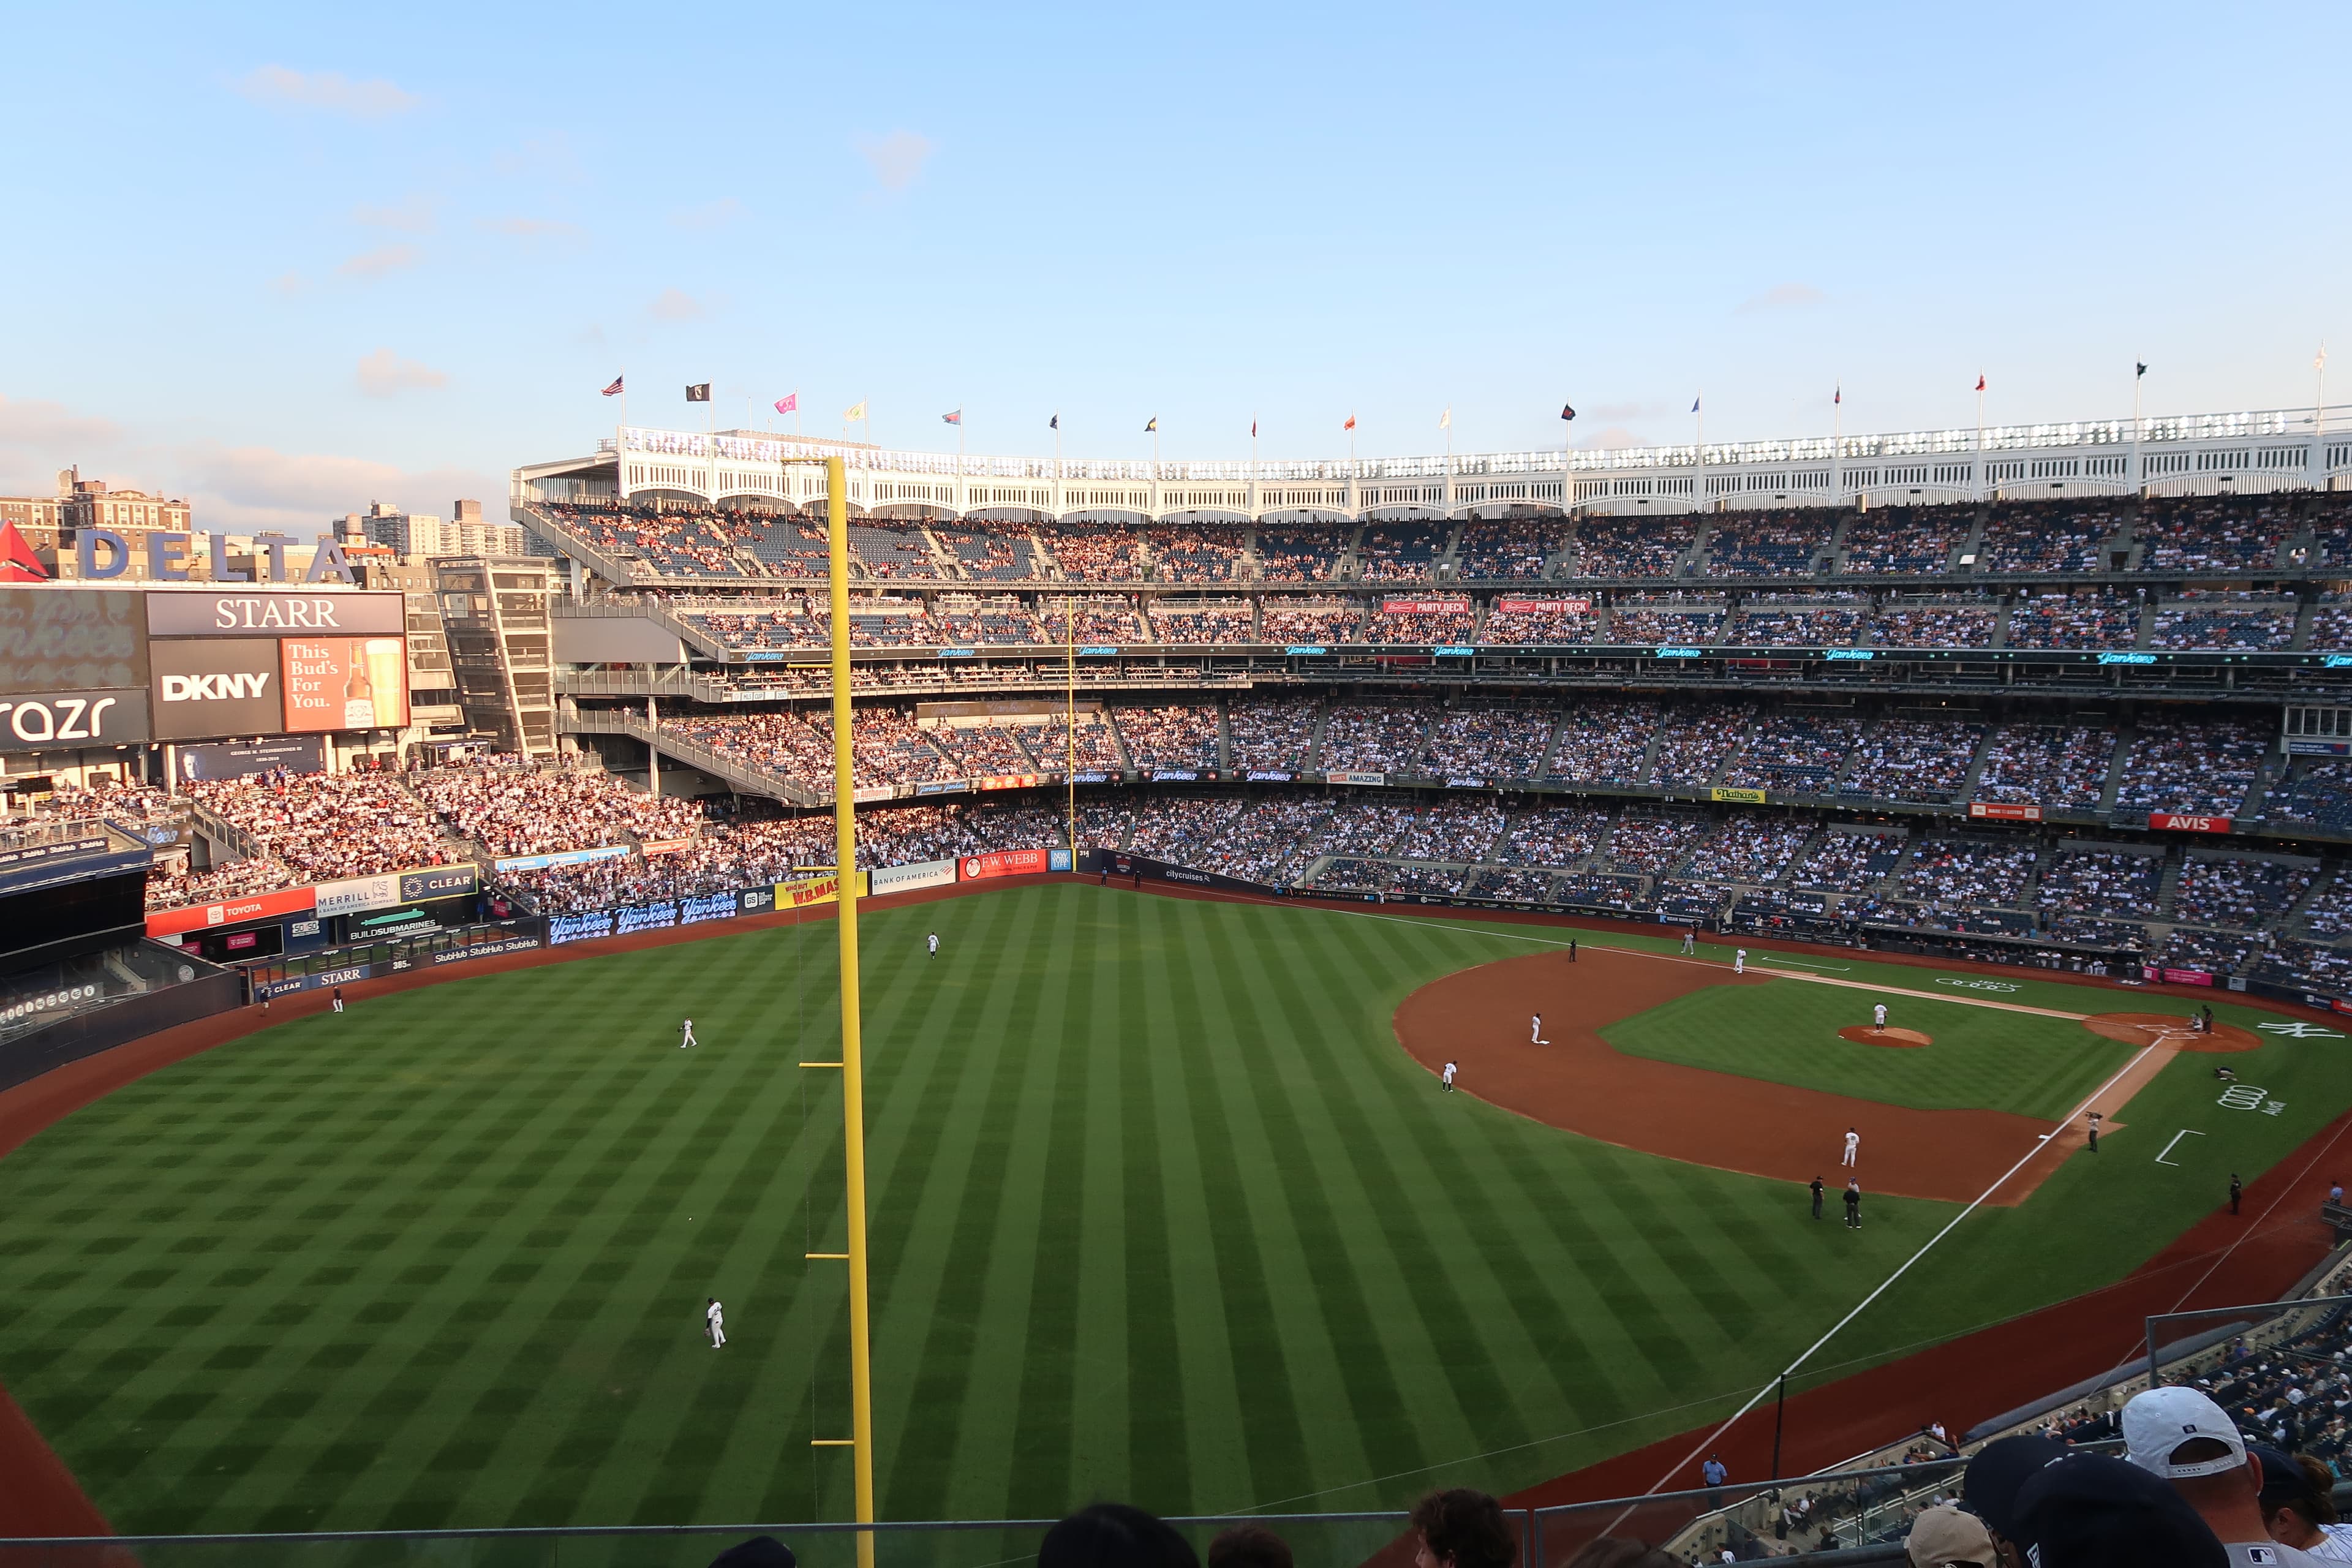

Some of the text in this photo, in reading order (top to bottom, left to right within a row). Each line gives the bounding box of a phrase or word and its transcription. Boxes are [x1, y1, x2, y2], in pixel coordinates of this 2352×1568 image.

[75, 529, 355, 582] DELTA
[1417, 603, 1442, 612] PARTY
[1443, 603, 1465, 612] DECK
[1536, 602, 1561, 611] PARTY
[1563, 602, 1586, 611] DECK
[216, 599, 341, 628] STARR
[288, 644, 330, 659] This
[744, 651, 784, 662] Yankees
[937, 648, 975, 658] Yankees
[1079, 646, 1118, 656] Yankees
[1286, 646, 1327, 656] Yankees
[1434, 646, 1474, 656] Yankees
[1656, 647, 1702, 658] Yankees
[1826, 649, 1874, 661] Yankees
[2098, 652, 2157, 665] Yankees
[290, 660, 339, 676] Bud's
[161, 673, 270, 702] DKNY
[291, 677, 322, 692] For
[291, 693, 331, 709] You.
[1063, 772, 1106, 784] Yankees
[1152, 770, 1197, 783] Yankees
[1246, 770, 1292, 783] Yankees
[1446, 776, 1485, 788] Yankees
[861, 788, 891, 799] Authority
[919, 783, 966, 794] Yankees Yankees
[1716, 788, 1759, 800] Nathan's
[2166, 816, 2211, 830] AVIS
[49, 844, 76, 854] StubHub
[79, 840, 105, 850] StubHub
[644, 843, 673, 853] Reebok
[22, 849, 46, 858] StubHub
[982, 853, 1038, 869] F.W. WEBB
[874, 876, 895, 886] BANK
[906, 870, 939, 881] AMERICA
[1166, 869, 1204, 882] citycruises
[429, 876, 470, 889] CLEAR
[318, 892, 370, 907] MERRILL
[226, 903, 262, 917] TOYOTA
[680, 896, 737, 922] Yankees
[614, 904, 677, 932] Yankees
[350, 919, 436, 940] BUILDSUBMARINES
[549, 914, 613, 941] Yankees
[470, 945, 503, 957] StubHub
[506, 939, 538, 951] StubHub
[435, 951, 468, 963] StubHub
[393, 960, 407, 970] 385
[321, 969, 361, 986] STARR
[274, 982, 301, 993] CLEAR
[2259, 1100, 2288, 1117] Audi
